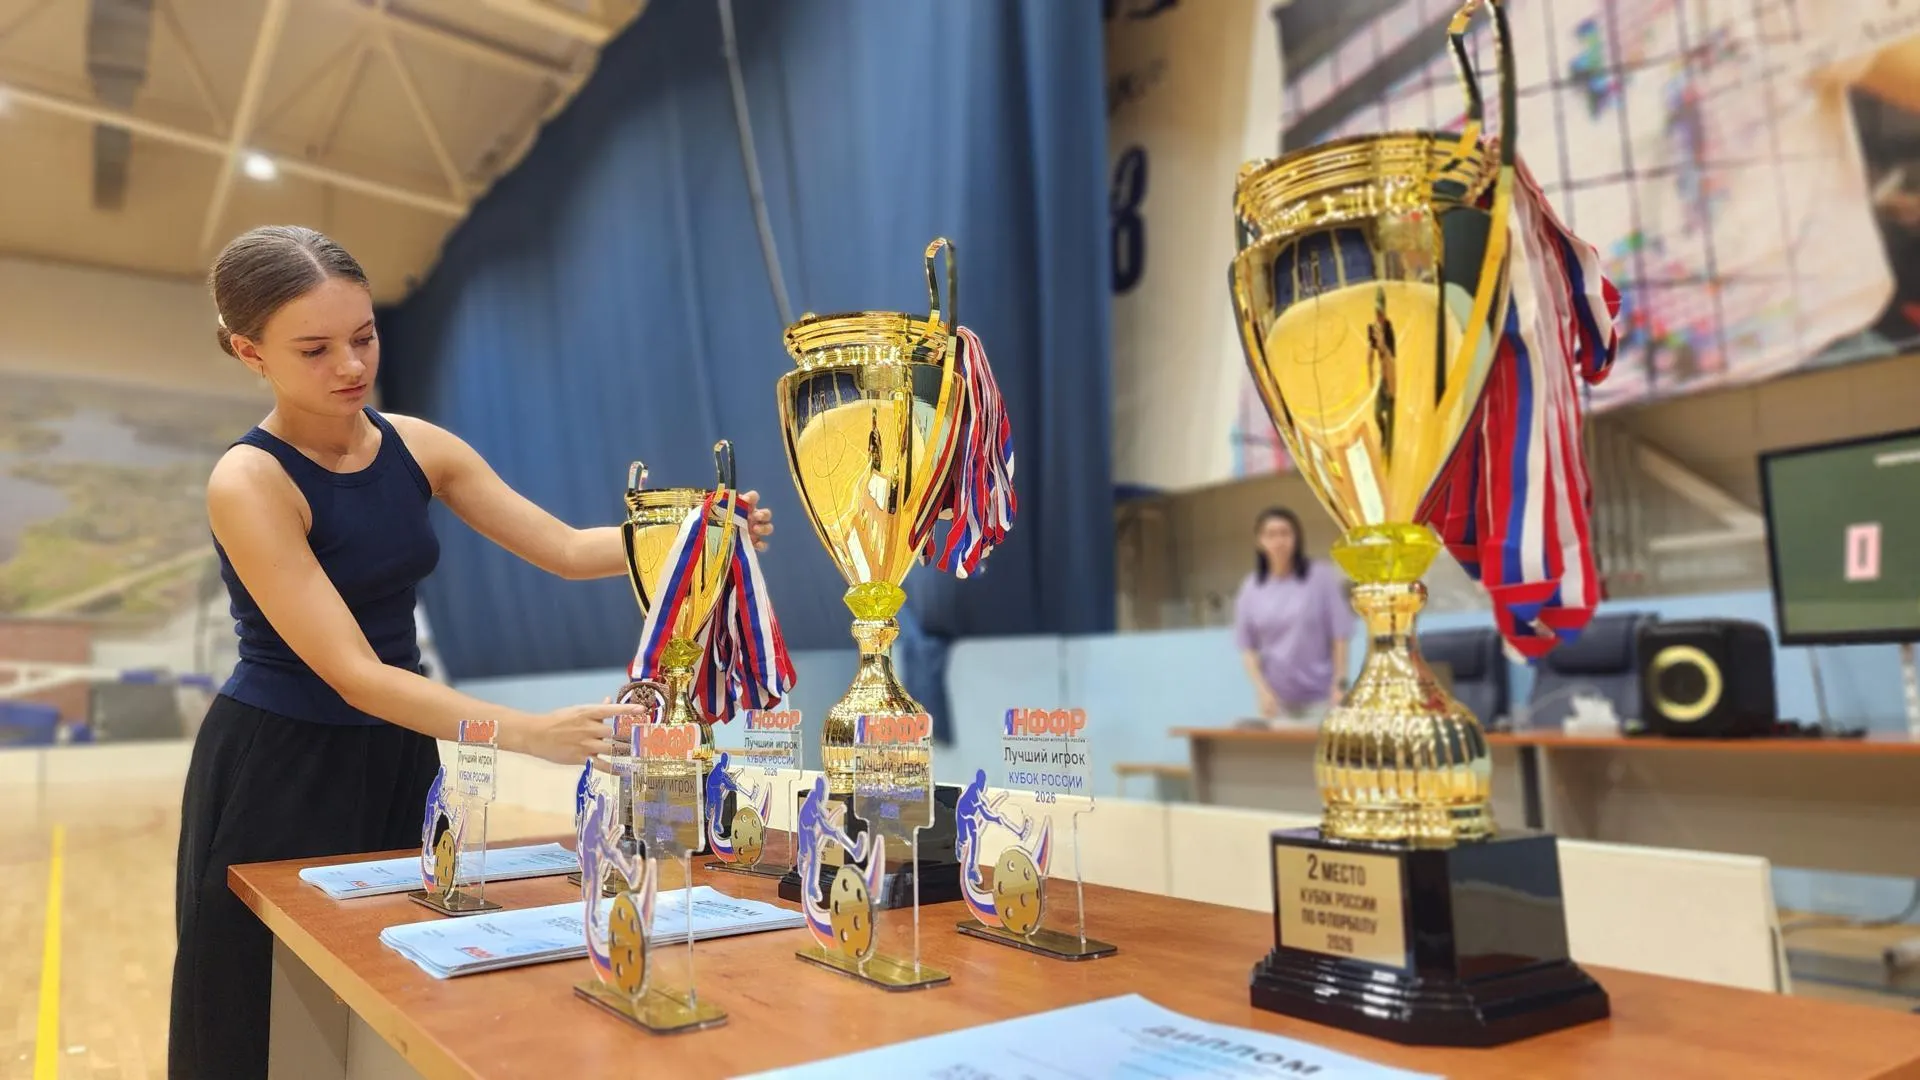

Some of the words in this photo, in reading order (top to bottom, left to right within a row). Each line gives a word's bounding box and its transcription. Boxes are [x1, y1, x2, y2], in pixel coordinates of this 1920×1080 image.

[752, 710, 800, 730] НФФР
[1013, 708, 1086, 737] НФФР
[745, 737, 774, 750] Лучший
[776, 740, 799, 751] игрок
[747, 754, 767, 764] КУБОК
[768, 756, 796, 765] РОССИИ
[1004, 747, 1048, 765] Лучший
[1051, 752, 1086, 768] игрок
[669, 780, 696, 797] игрок
[1009, 771, 1039, 785] КУБОК
[1041, 773, 1083, 789] РОССИИ
[1035, 790, 1057, 804] 2026
[1306, 853, 1318, 880] 2
[1321, 861, 1366, 888] МЕСТО
[1300, 887, 1333, 906] КУБОК
[1335, 891, 1378, 913] РОССИИ
[1301, 907, 1316, 926] ПО
[1142, 1024, 1324, 1076] ДИПЛОМ
